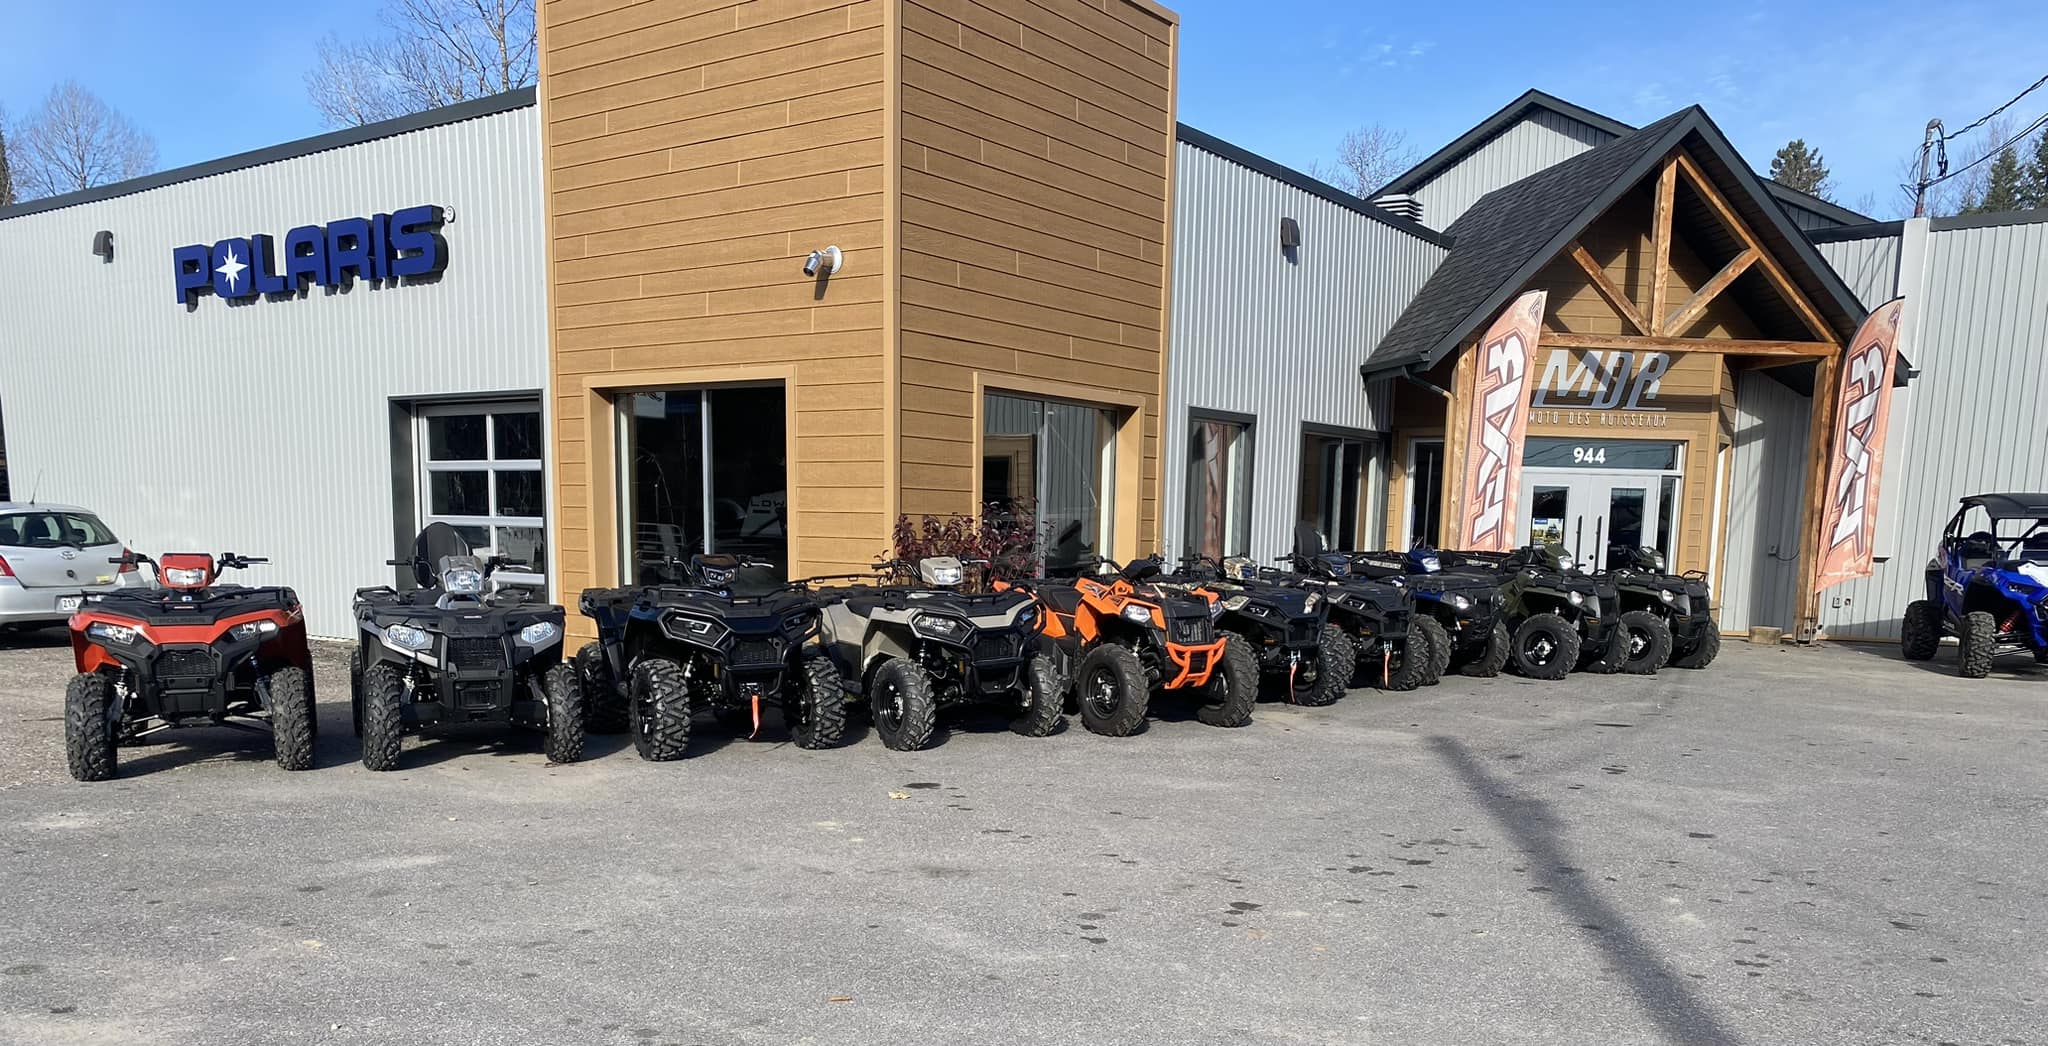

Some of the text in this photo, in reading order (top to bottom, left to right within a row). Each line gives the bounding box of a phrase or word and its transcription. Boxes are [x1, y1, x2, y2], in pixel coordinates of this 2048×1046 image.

[173, 205, 446, 306] POLARIS
[1532, 348, 1670, 411] MDR
[1528, 410, 1667, 427] MOTO DES RUISSEAUX
[1573, 447, 1606, 464] 944
